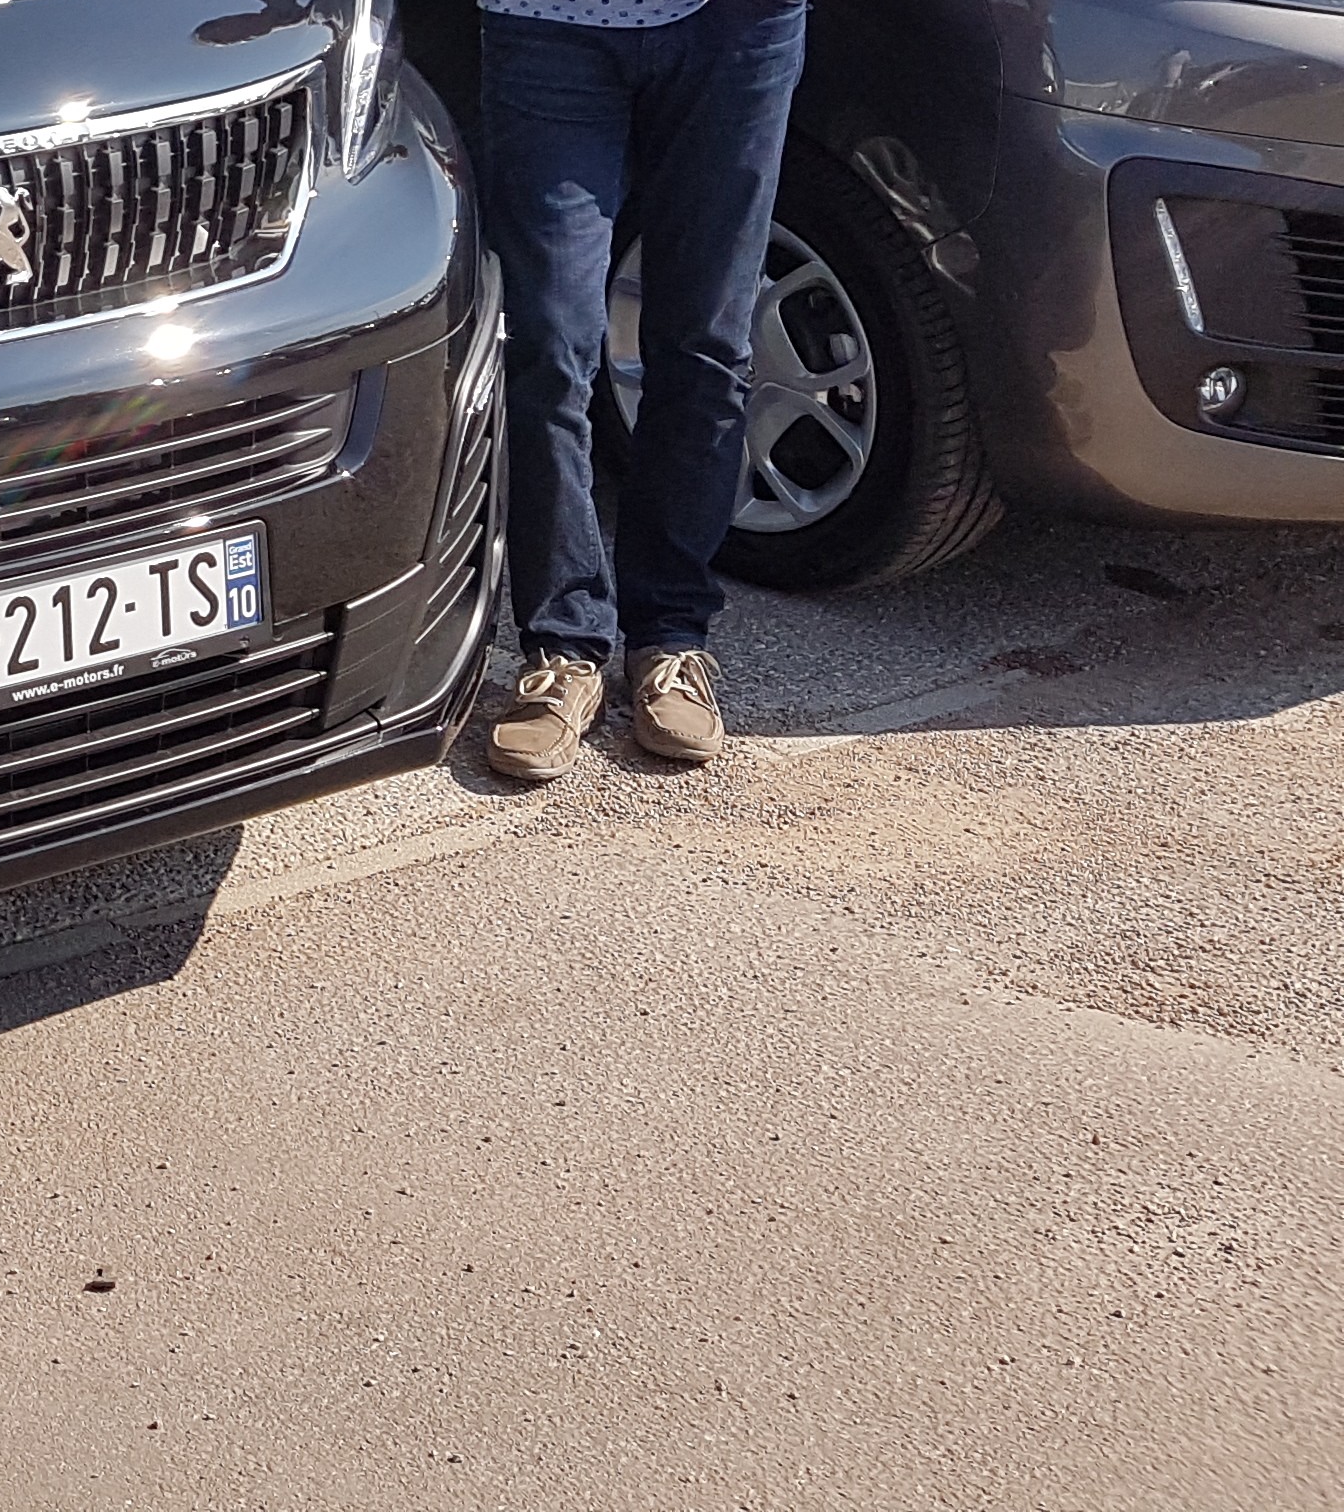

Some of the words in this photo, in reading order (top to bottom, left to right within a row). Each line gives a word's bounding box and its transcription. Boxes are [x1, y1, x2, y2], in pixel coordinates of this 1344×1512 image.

[228, 542, 252, 555] Grand
[229, 551, 253, 570] Est
[228, 584, 256, 622] 10
[12, 663, 125, 702] www.e-motors.fr
